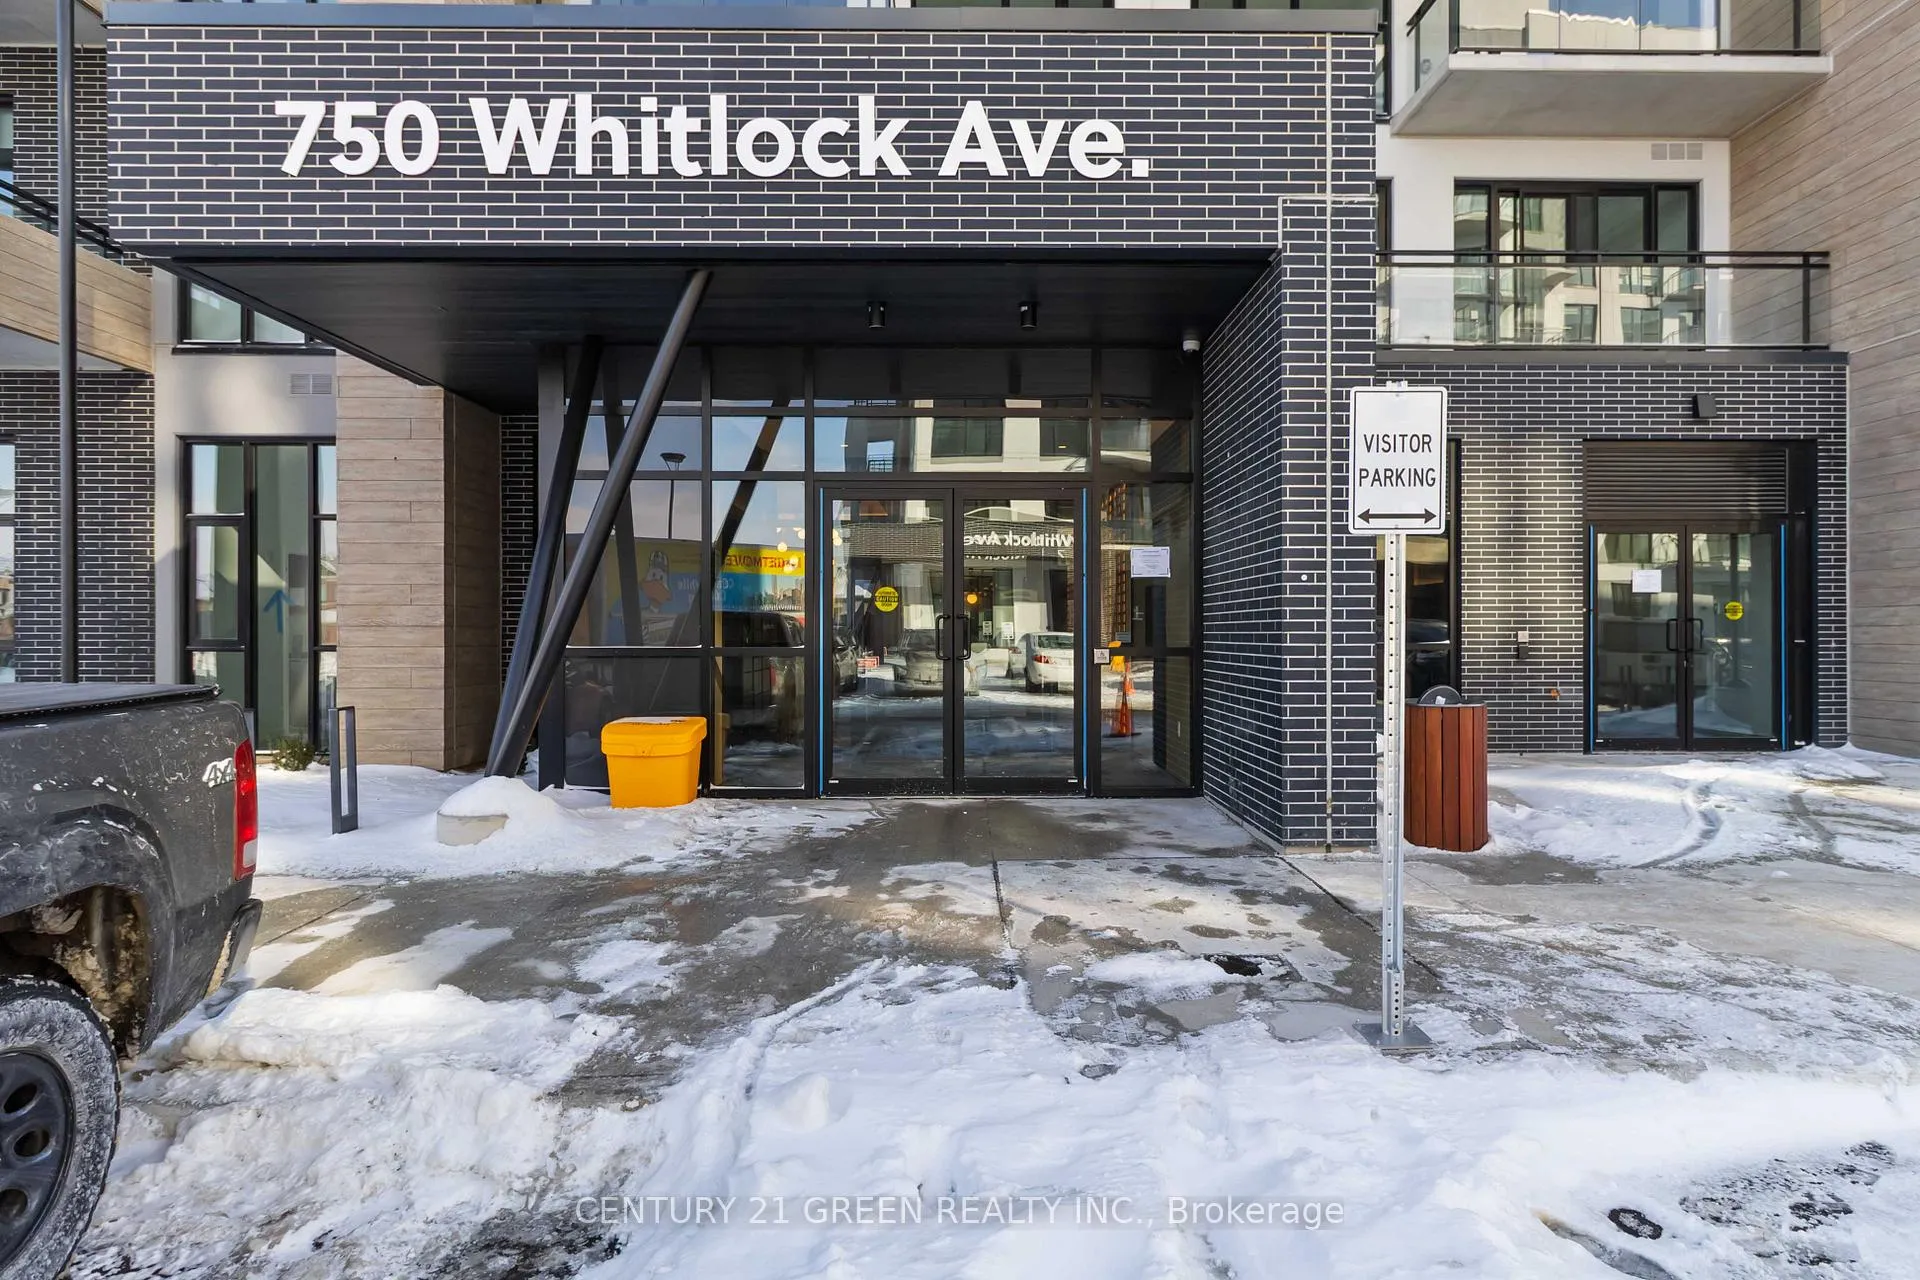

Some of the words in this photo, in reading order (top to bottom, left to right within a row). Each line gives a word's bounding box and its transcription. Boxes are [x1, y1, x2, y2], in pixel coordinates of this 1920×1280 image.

[274, 100, 440, 177] 750
[468, 93, 912, 177] Whitlock
[938, 100, 1150, 179] Ave.
[1363, 433, 1433, 453] VISITOR
[1359, 467, 1436, 487] PARKING
